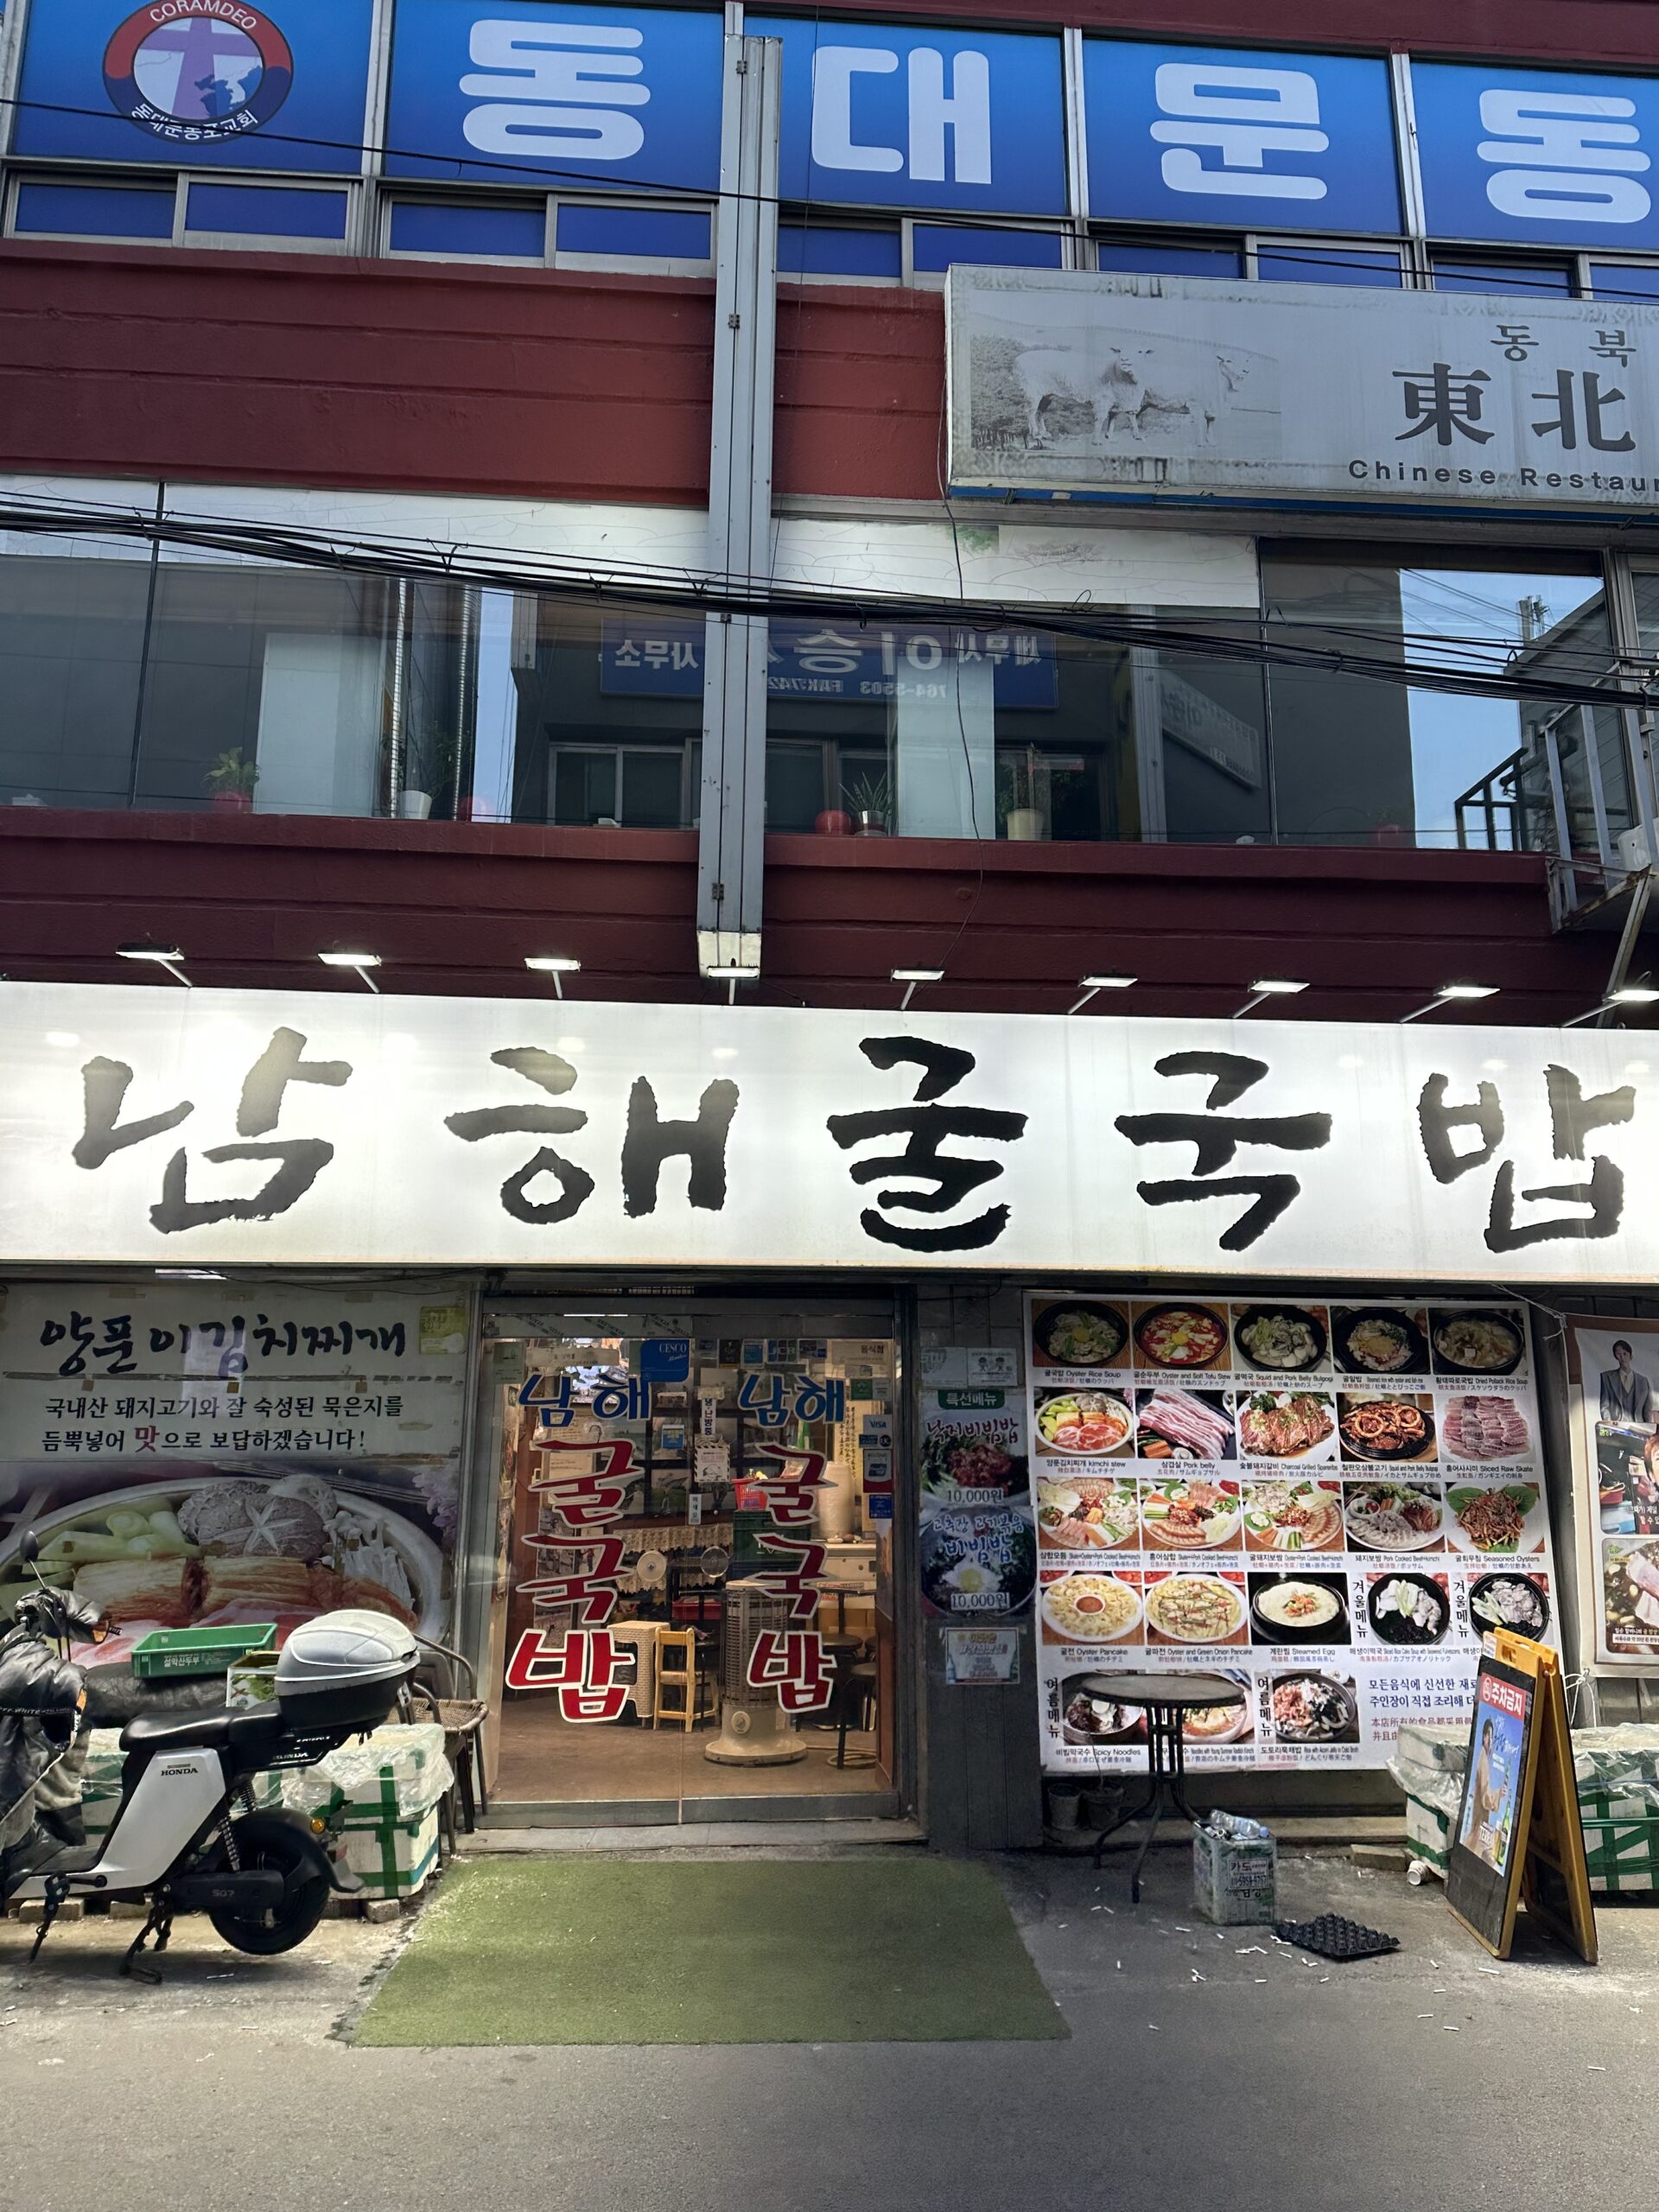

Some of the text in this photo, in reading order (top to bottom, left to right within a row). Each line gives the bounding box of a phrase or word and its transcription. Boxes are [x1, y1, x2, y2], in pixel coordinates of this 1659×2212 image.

[149, 0, 257, 29] CORAMDEO
[1392, 363, 1636, 451] 東北
[1349, 460, 1496, 484] Chinese
[659, 1343, 687, 1353] CESCO
[46, 1394, 404, 1419] 국내산 돼지고기와 잘 숙성된 묵은지를
[518, 1373, 652, 1428] 남해
[737, 1373, 849, 1426] 남해
[947, 1392, 997, 1406] 특선메뉴
[41, 1426, 365, 1452] 듬뿍넣어 맛으로 보답하겠습니다!
[927, 1420, 1020, 1445] 낙지비빔밥
[948, 1489, 1004, 1503] 10,000원
[933, 1516, 1024, 1535] 고추장 고기볶음
[944, 1536, 1013, 1564] 비빔밥
[505, 1439, 645, 1723] 굴국밥
[747, 1441, 839, 1713] 굴국밥
[952, 1593, 1008, 1609] 10,000원
[1353, 1580, 1368, 1637] 겨울메뉴
[1453, 1580, 1469, 1637] 겨울메뉴
[163, 1656, 200, 1668] 설악산두부
[1369, 1679, 1421, 1691] 모든음식에
[1424, 1679, 1455, 1691] 신선한
[1045, 1677, 1061, 1738] 여름메뉴
[1257, 1677, 1274, 1737] 여름메뉴
[1370, 1695, 1464, 1707] 주인장이 직접 조리해
[1491, 1682, 1523, 1715] 주차금지
[161, 1767, 198, 1777] HONDA
